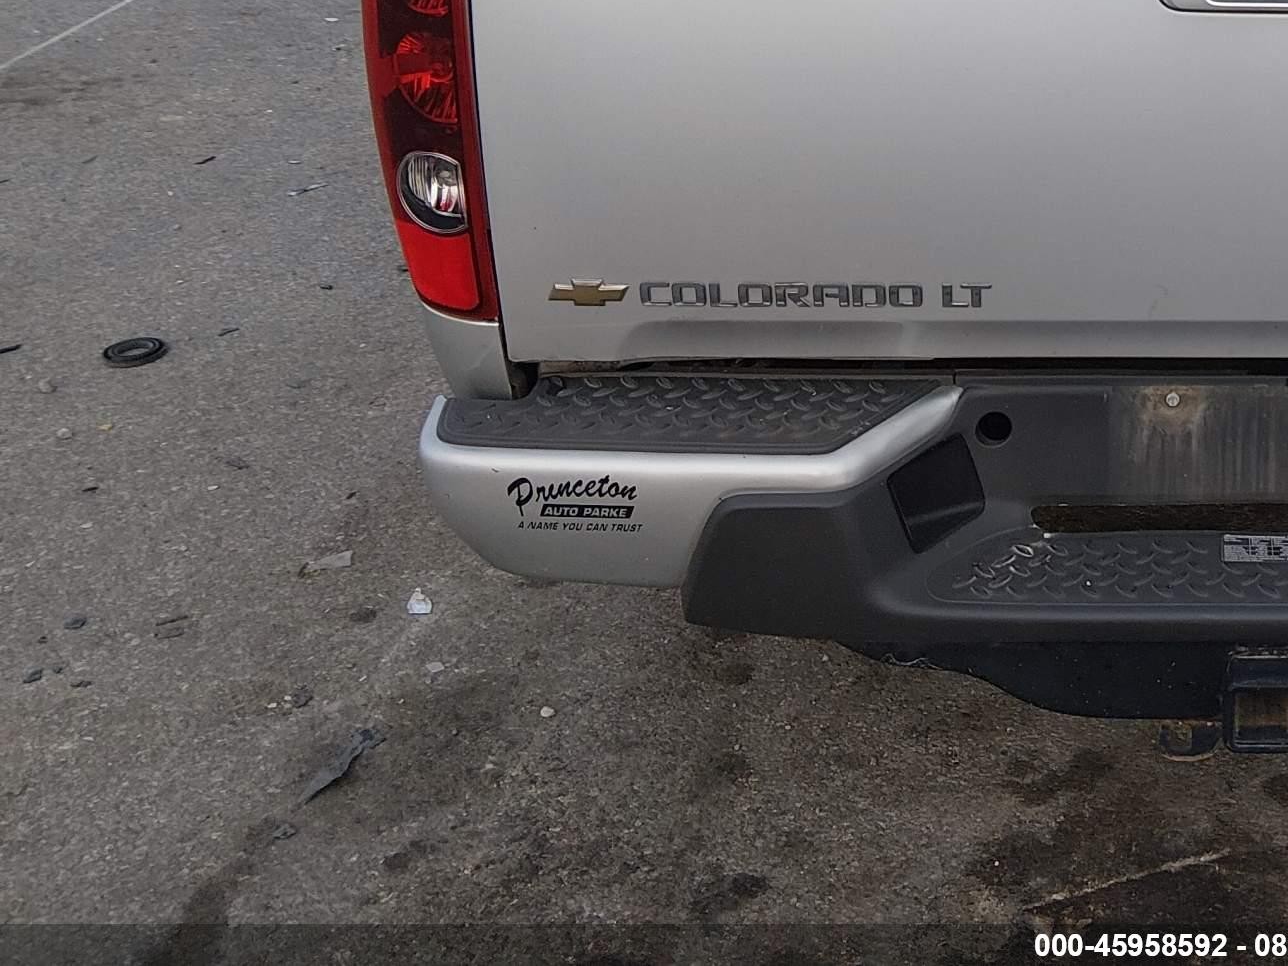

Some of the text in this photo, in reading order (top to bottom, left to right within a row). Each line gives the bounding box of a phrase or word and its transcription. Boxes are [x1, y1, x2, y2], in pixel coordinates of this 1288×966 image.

[639, 282, 992, 308] COLORADO LT
[507, 475, 638, 516] Princeton
[543, 506, 628, 518] AUTO PARKE
[527, 521, 558, 531] NAME
[562, 522, 583, 531] YOU
[586, 523, 609, 532] CAN
[611, 523, 643, 532] TRUST
